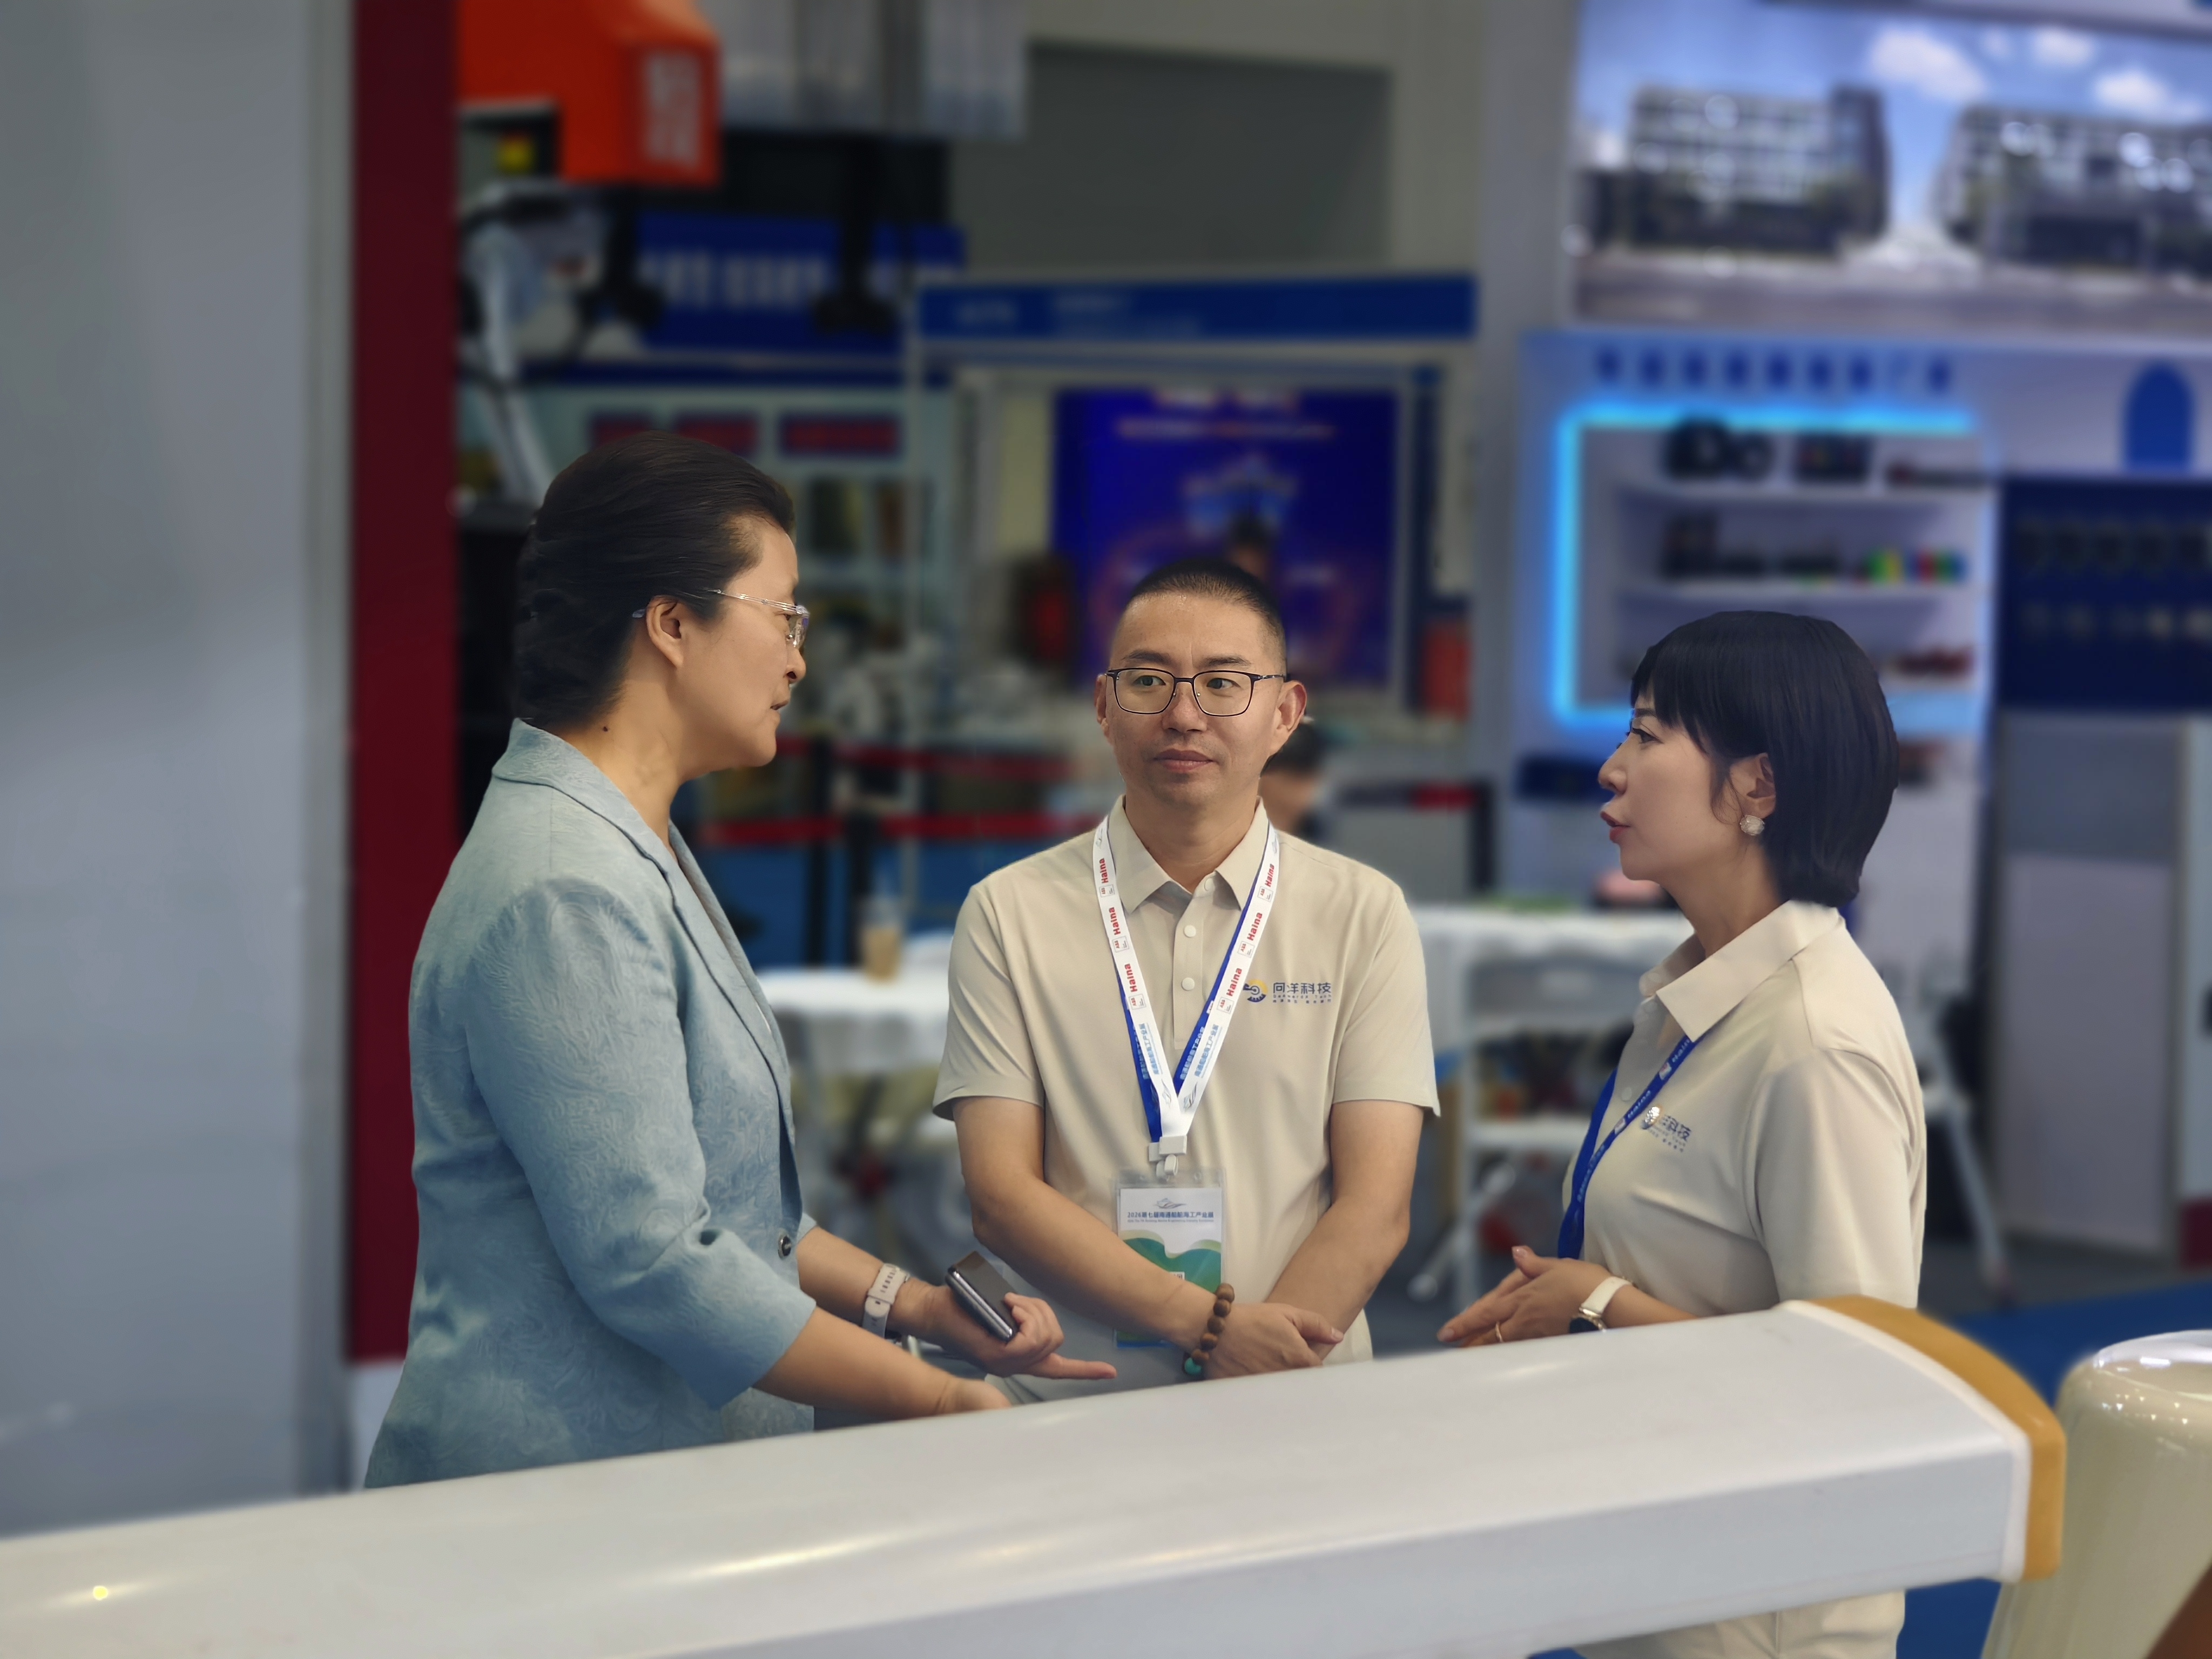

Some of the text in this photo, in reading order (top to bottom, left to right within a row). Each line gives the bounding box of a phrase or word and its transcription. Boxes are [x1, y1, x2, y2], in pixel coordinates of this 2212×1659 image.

[1099, 858, 1109, 884] Haina
[1265, 864, 1274, 887] Haina
[1109, 907, 1121, 935] Haina
[1247, 912, 1263, 941] Haina
[1124, 963, 1138, 993] Haina
[1226, 968, 1242, 996] Haina
[1273, 982, 1332, 994] 向洋科技
